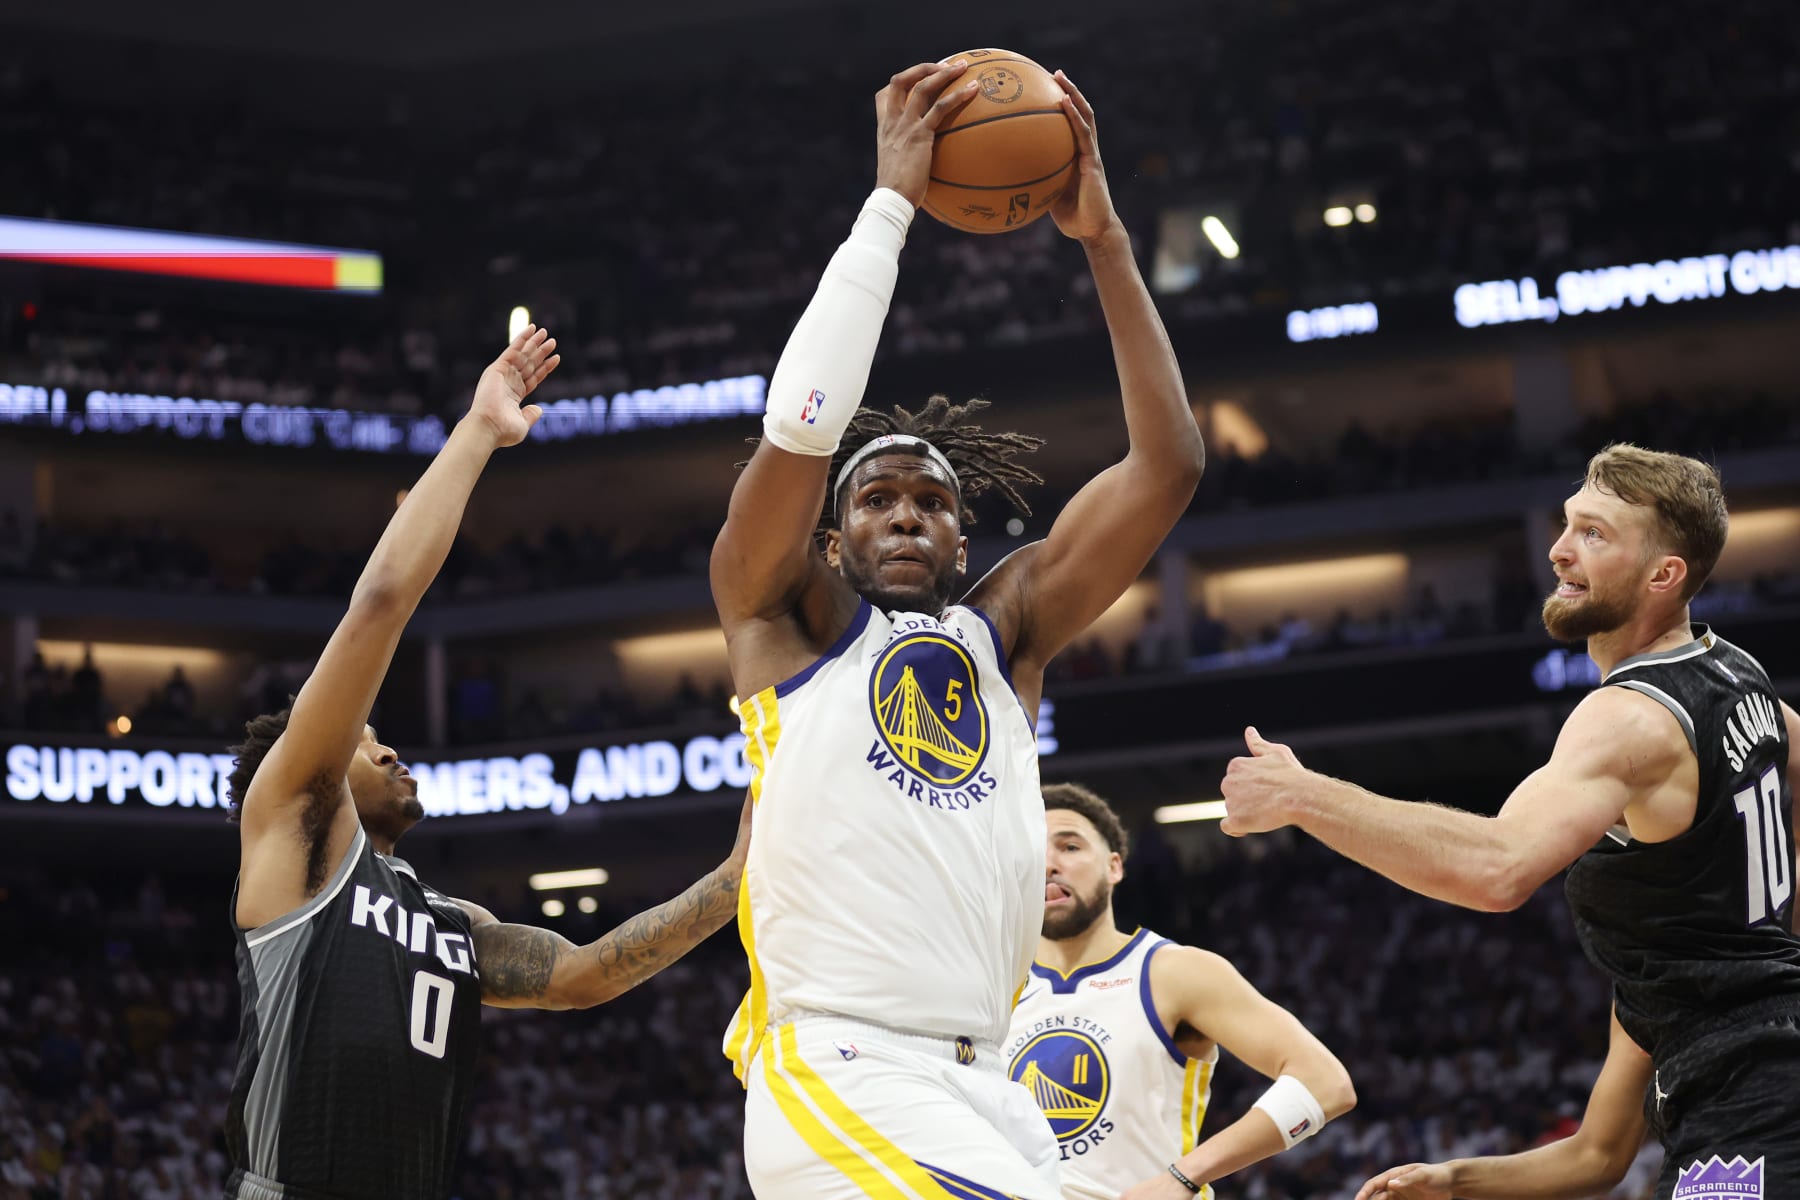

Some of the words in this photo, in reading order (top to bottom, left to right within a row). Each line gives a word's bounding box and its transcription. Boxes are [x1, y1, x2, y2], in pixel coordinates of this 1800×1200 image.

[944, 678, 963, 722] 5
[571, 740, 681, 804] AND
[865, 739, 997, 810] WARRIORS
[1732, 763, 1792, 926] 10
[410, 969, 455, 1060] 0
[1007, 1014, 1065, 1058] GOLDEN
[1072, 1016, 1112, 1045] STATE
[1072, 1053, 1090, 1085] 11
[1058, 1118, 1115, 1161] IORS
[1677, 1182, 1759, 1196] SACRAMENTO
